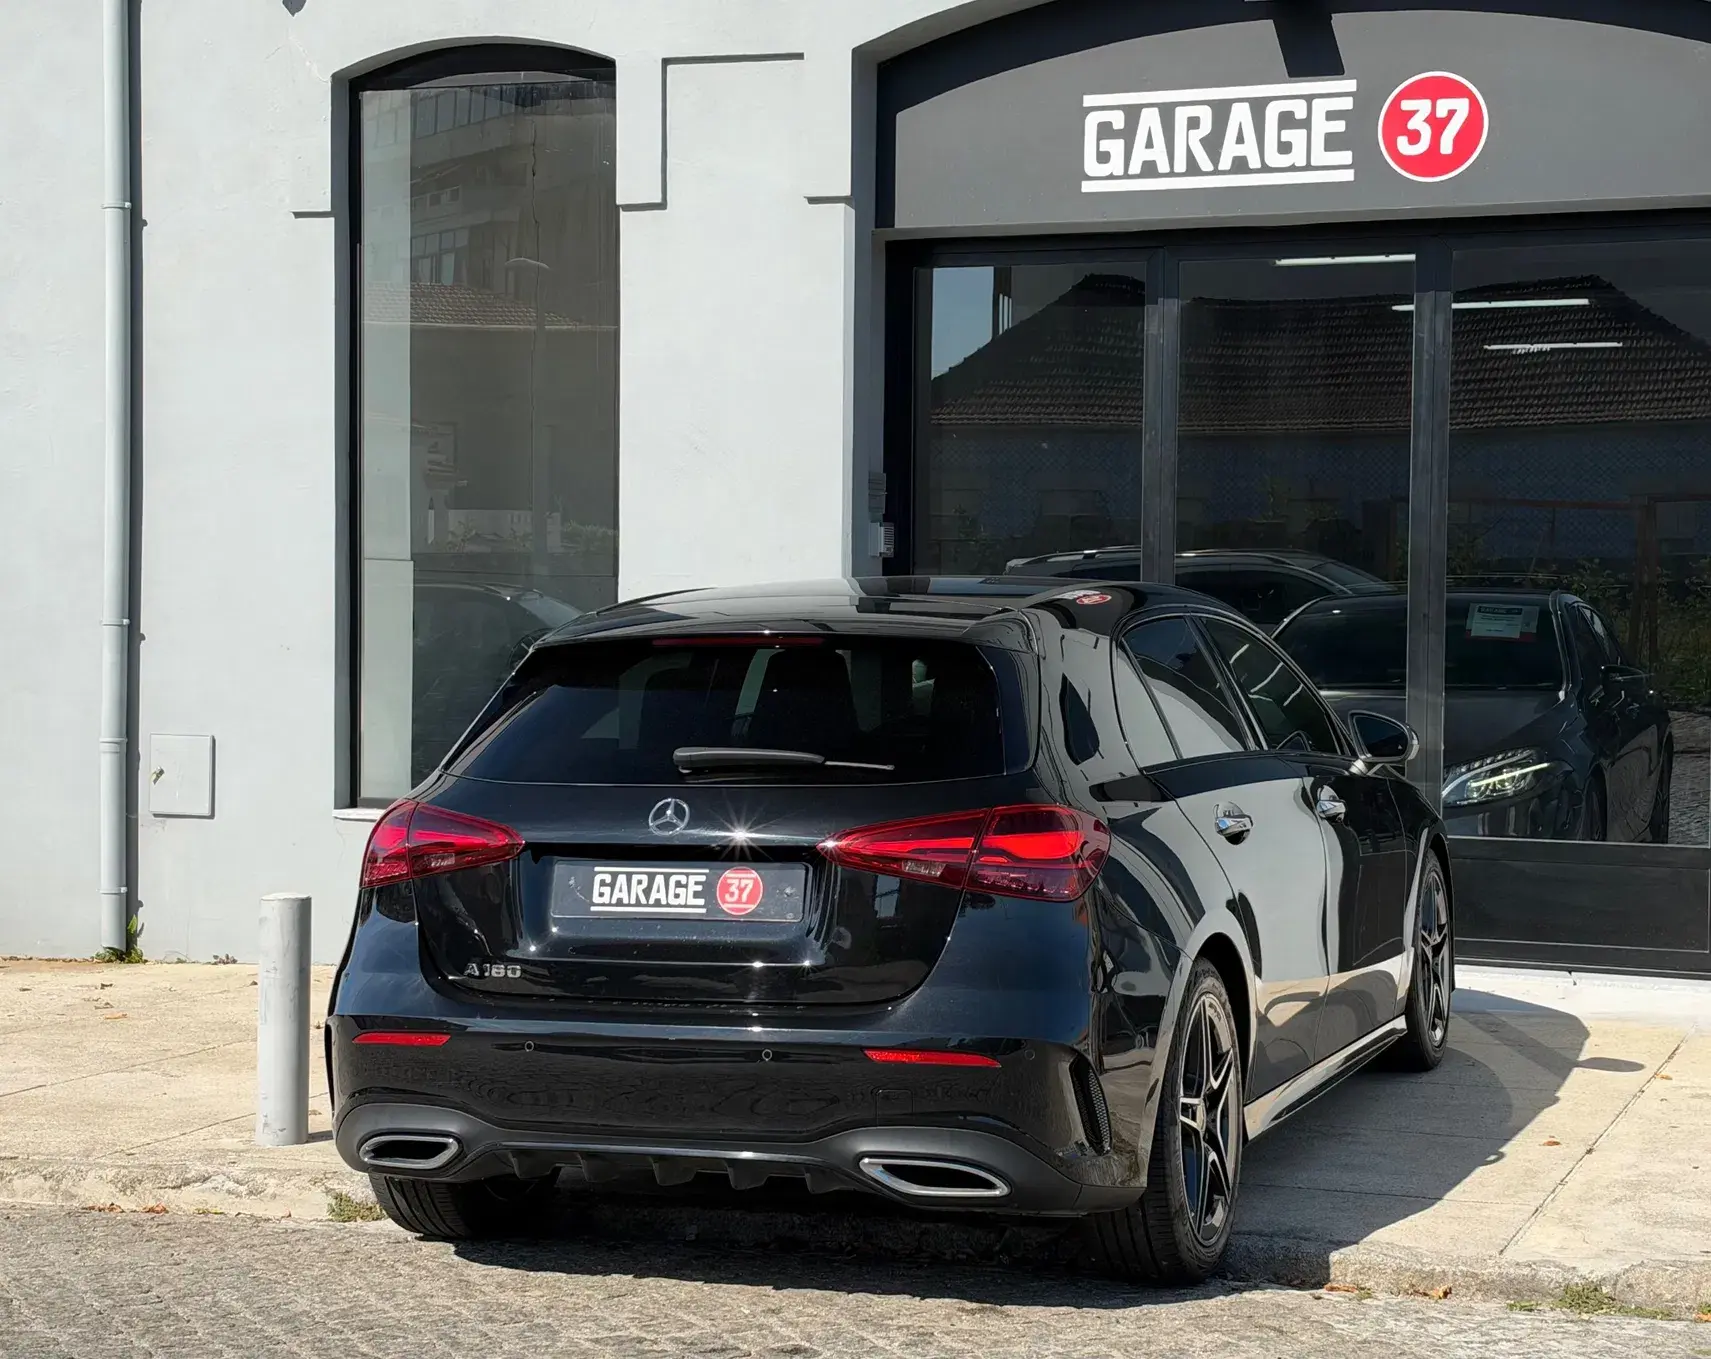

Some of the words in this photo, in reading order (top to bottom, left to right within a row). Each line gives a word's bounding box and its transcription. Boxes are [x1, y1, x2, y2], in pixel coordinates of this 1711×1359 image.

[1084, 96, 1354, 177] GARAGE
[1396, 97, 1470, 156] 37
[592, 873, 707, 906] GARAGE
[724, 878, 754, 904] 37
